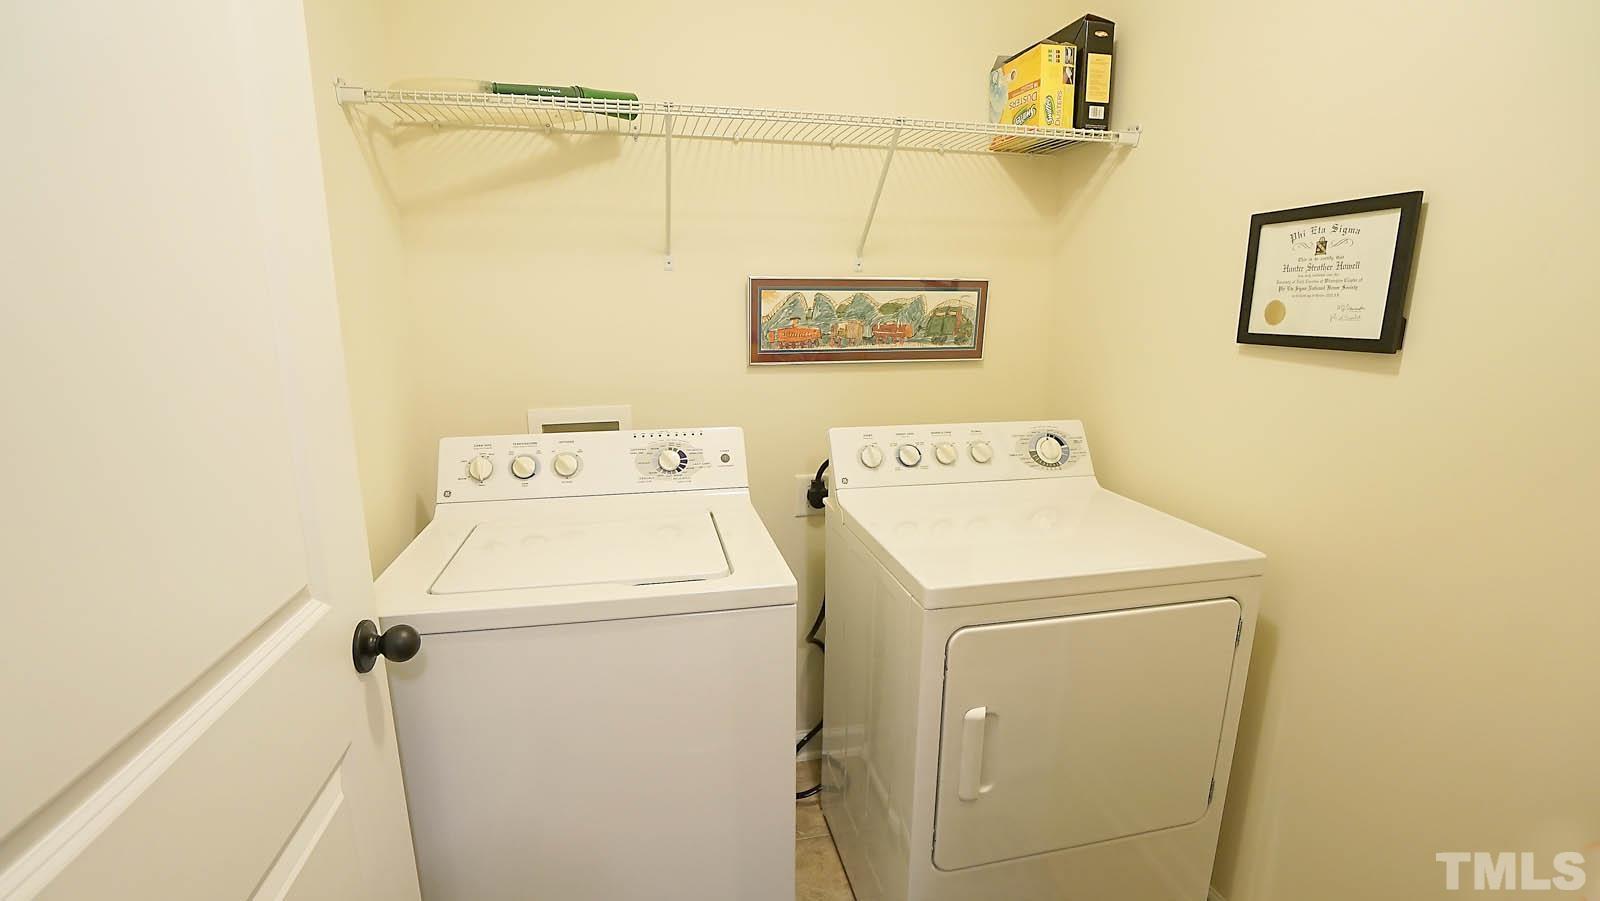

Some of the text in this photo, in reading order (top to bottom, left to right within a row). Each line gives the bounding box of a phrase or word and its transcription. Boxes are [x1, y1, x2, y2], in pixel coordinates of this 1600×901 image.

[1290, 223, 1361, 244] Phi Eta Sigma
